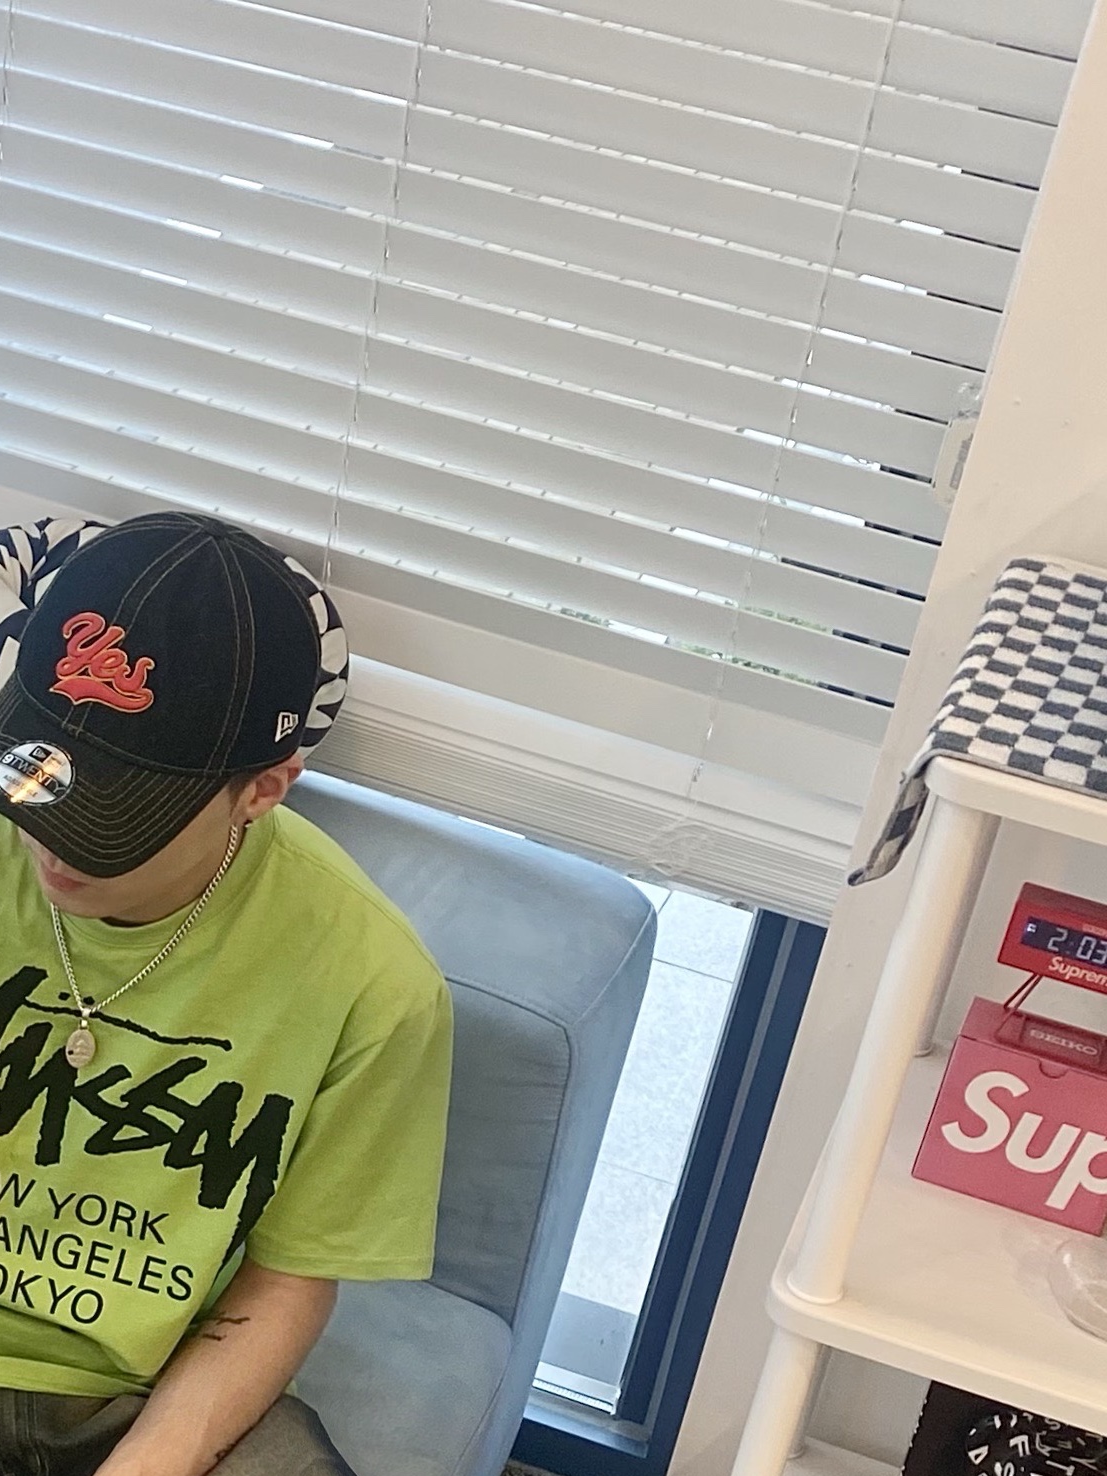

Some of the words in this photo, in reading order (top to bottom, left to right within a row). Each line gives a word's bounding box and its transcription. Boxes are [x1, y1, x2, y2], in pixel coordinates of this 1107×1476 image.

[53, 611, 156, 694] Yes
[1, 753, 68, 793] 9TWENTY
[1030, 1028, 1098, 1056] SEIKO
[941, 1070, 1107, 1210] Sup
[48, 1187, 170, 1244] YORK
